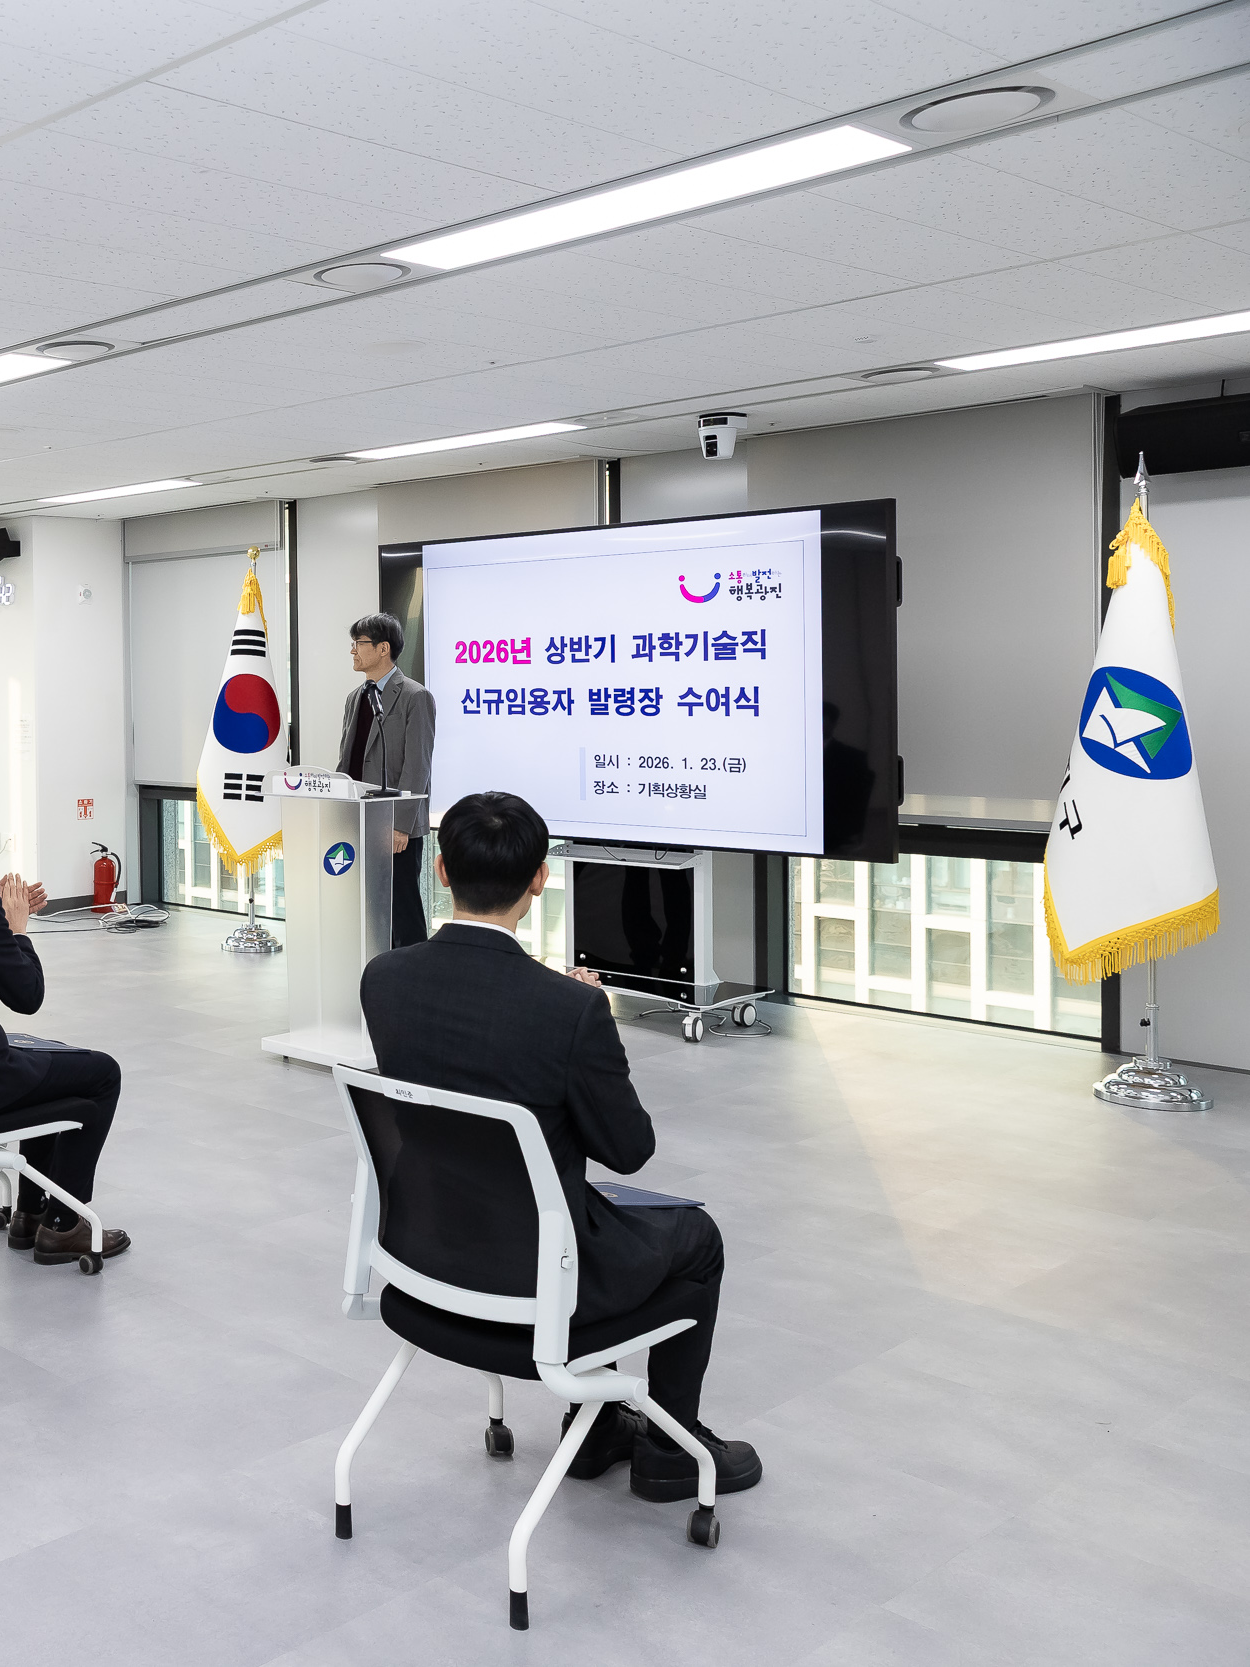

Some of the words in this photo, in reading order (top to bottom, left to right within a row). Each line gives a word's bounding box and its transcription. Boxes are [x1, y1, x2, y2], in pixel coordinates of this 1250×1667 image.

[729, 583, 782, 601] 행복광진
[454, 637, 532, 665] 2026년
[545, 634, 616, 665] 상반기
[631, 628, 767, 663] 과학기술직
[461, 687, 575, 717] 신규임용자
[588, 687, 663, 717] 발령장
[677, 685, 760, 718] 수여식
[594, 754, 620, 769] 일시
[638, 756, 674, 769] 2026.
[681, 757, 693, 770] 1.
[700, 757, 747, 774] 23.(금)
[305, 780, 330, 792] 행복광진
[593, 780, 620, 796] 장소
[638, 782, 707, 800] 기획상황실
